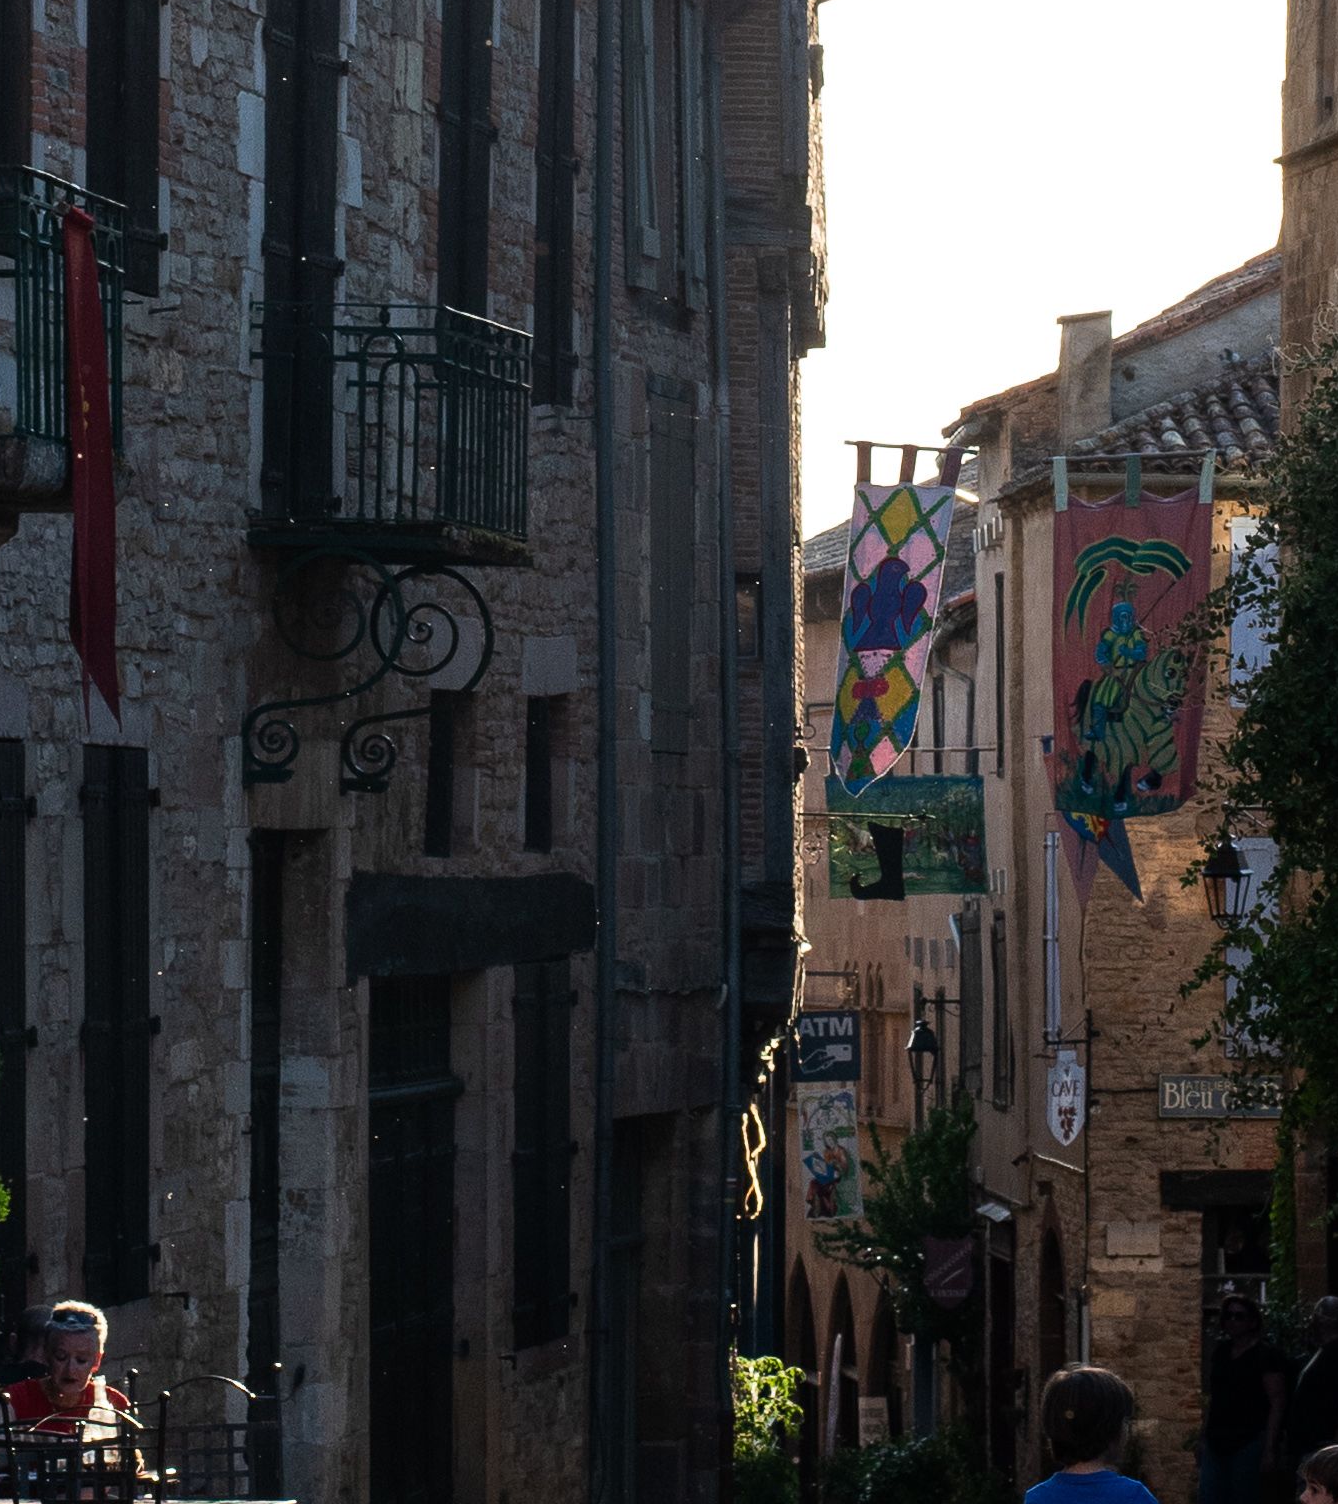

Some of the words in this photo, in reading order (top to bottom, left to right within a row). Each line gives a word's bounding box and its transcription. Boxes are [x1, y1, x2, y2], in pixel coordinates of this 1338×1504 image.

[799, 1016, 854, 1037] ATM
[1051, 1080, 1081, 1097] CAVE
[1162, 1079, 1213, 1110] Bleu
